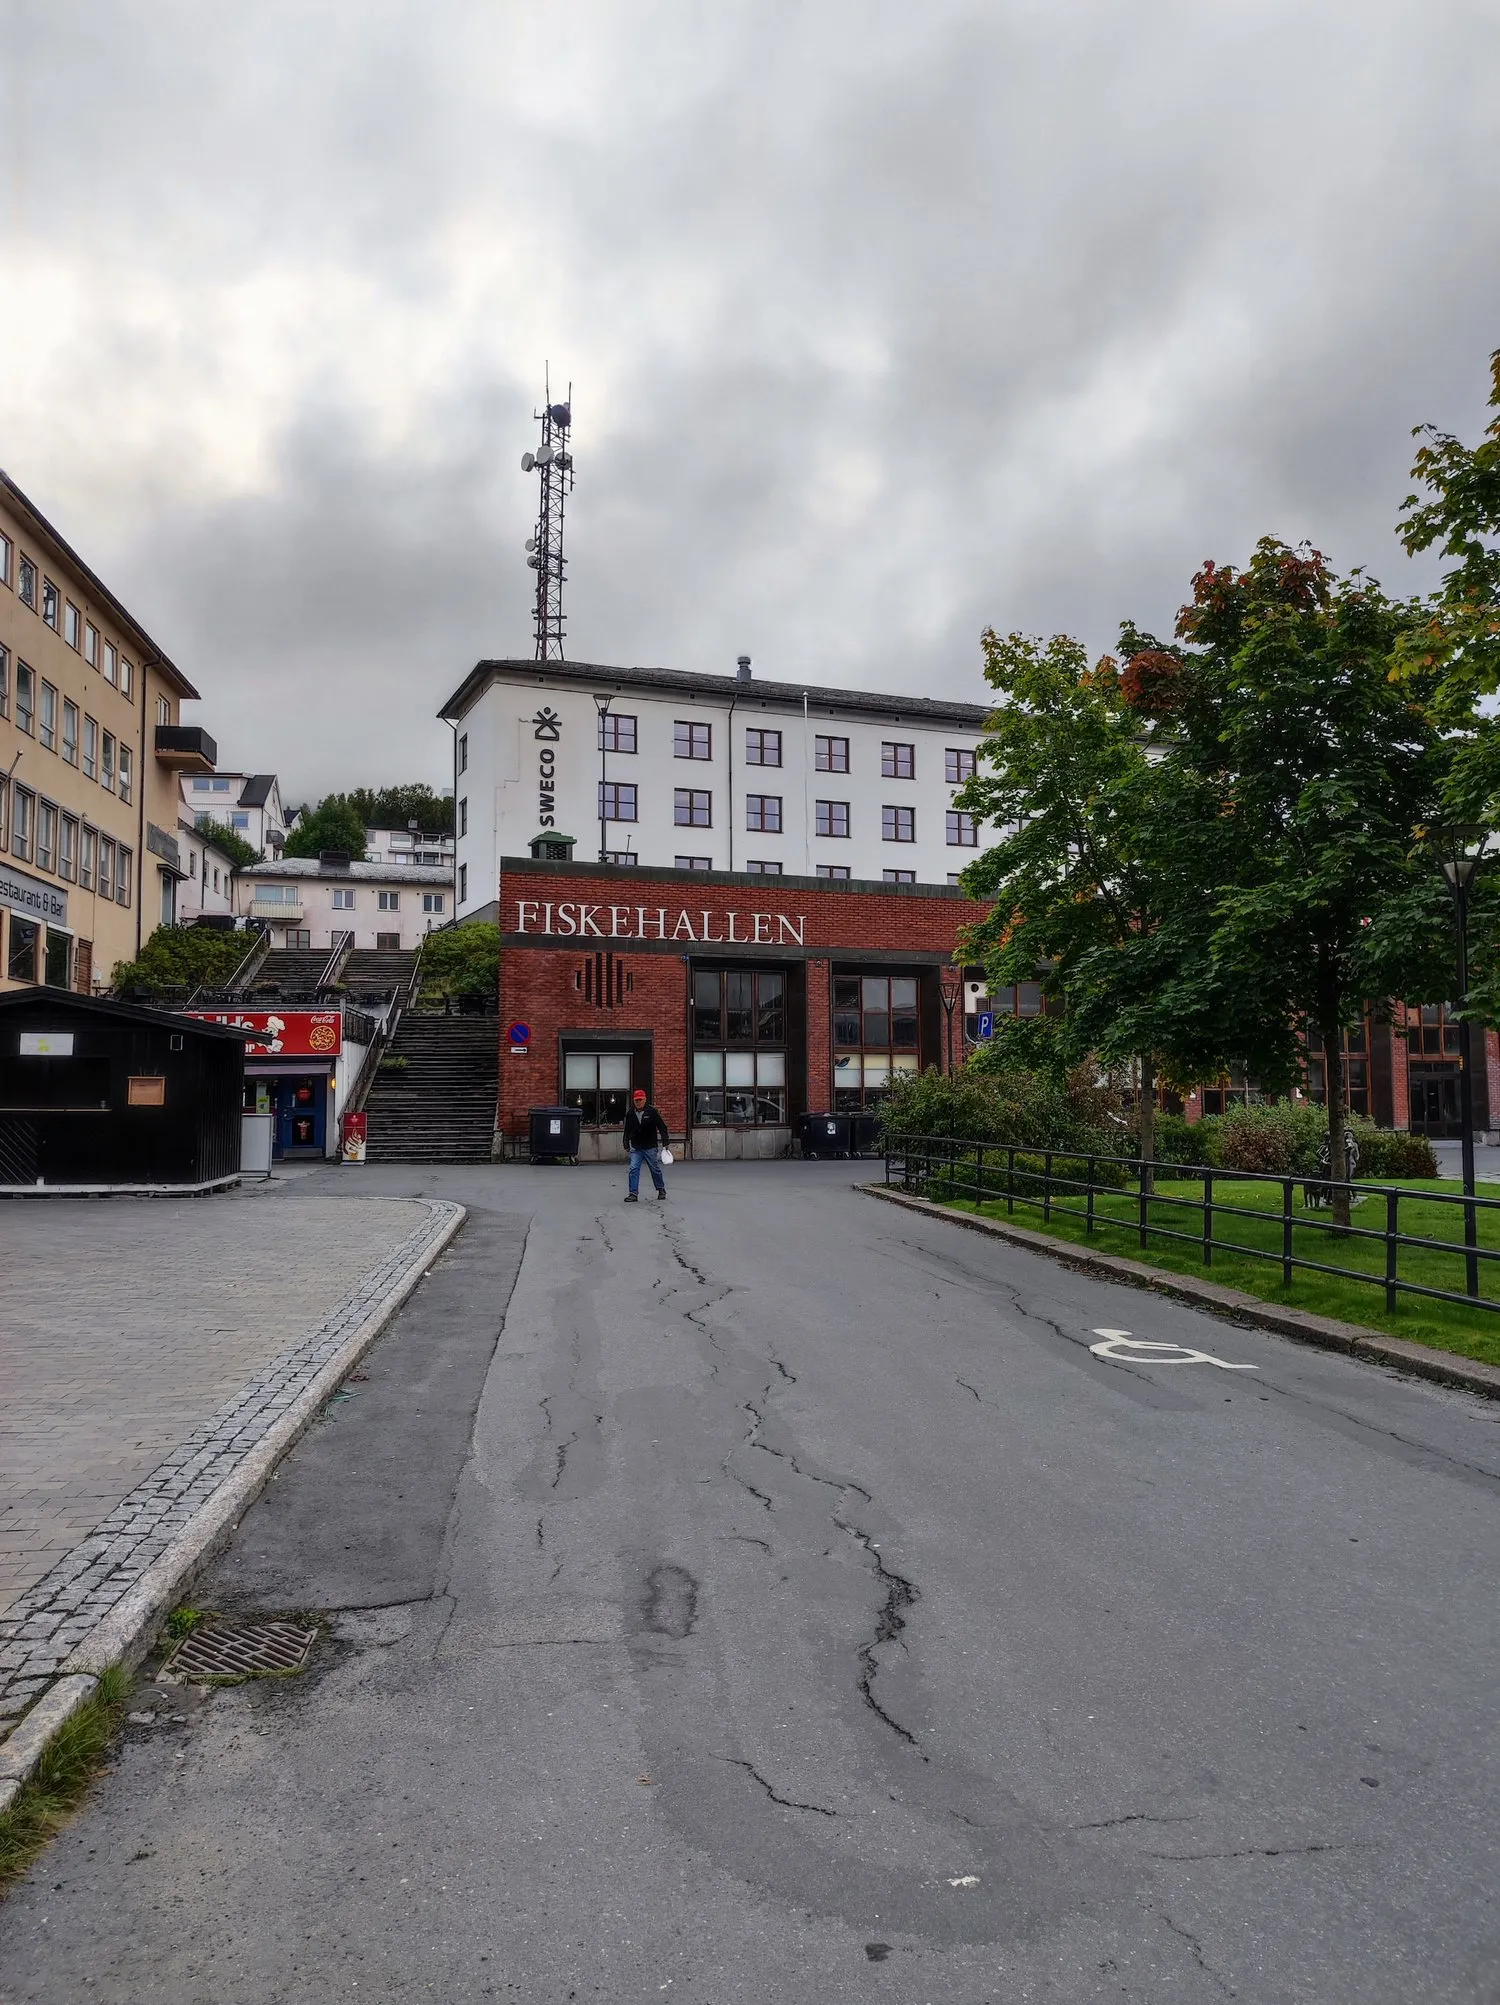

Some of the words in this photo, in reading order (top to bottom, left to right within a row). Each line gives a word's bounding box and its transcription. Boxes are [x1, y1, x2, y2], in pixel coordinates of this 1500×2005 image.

[540, 748, 555, 827] SWECO
[43, 893, 49, 912] &
[51, 895, 64, 917] Bar
[514, 900, 807, 946] FISKEHALLEN
[980, 1016, 989, 1036] P
